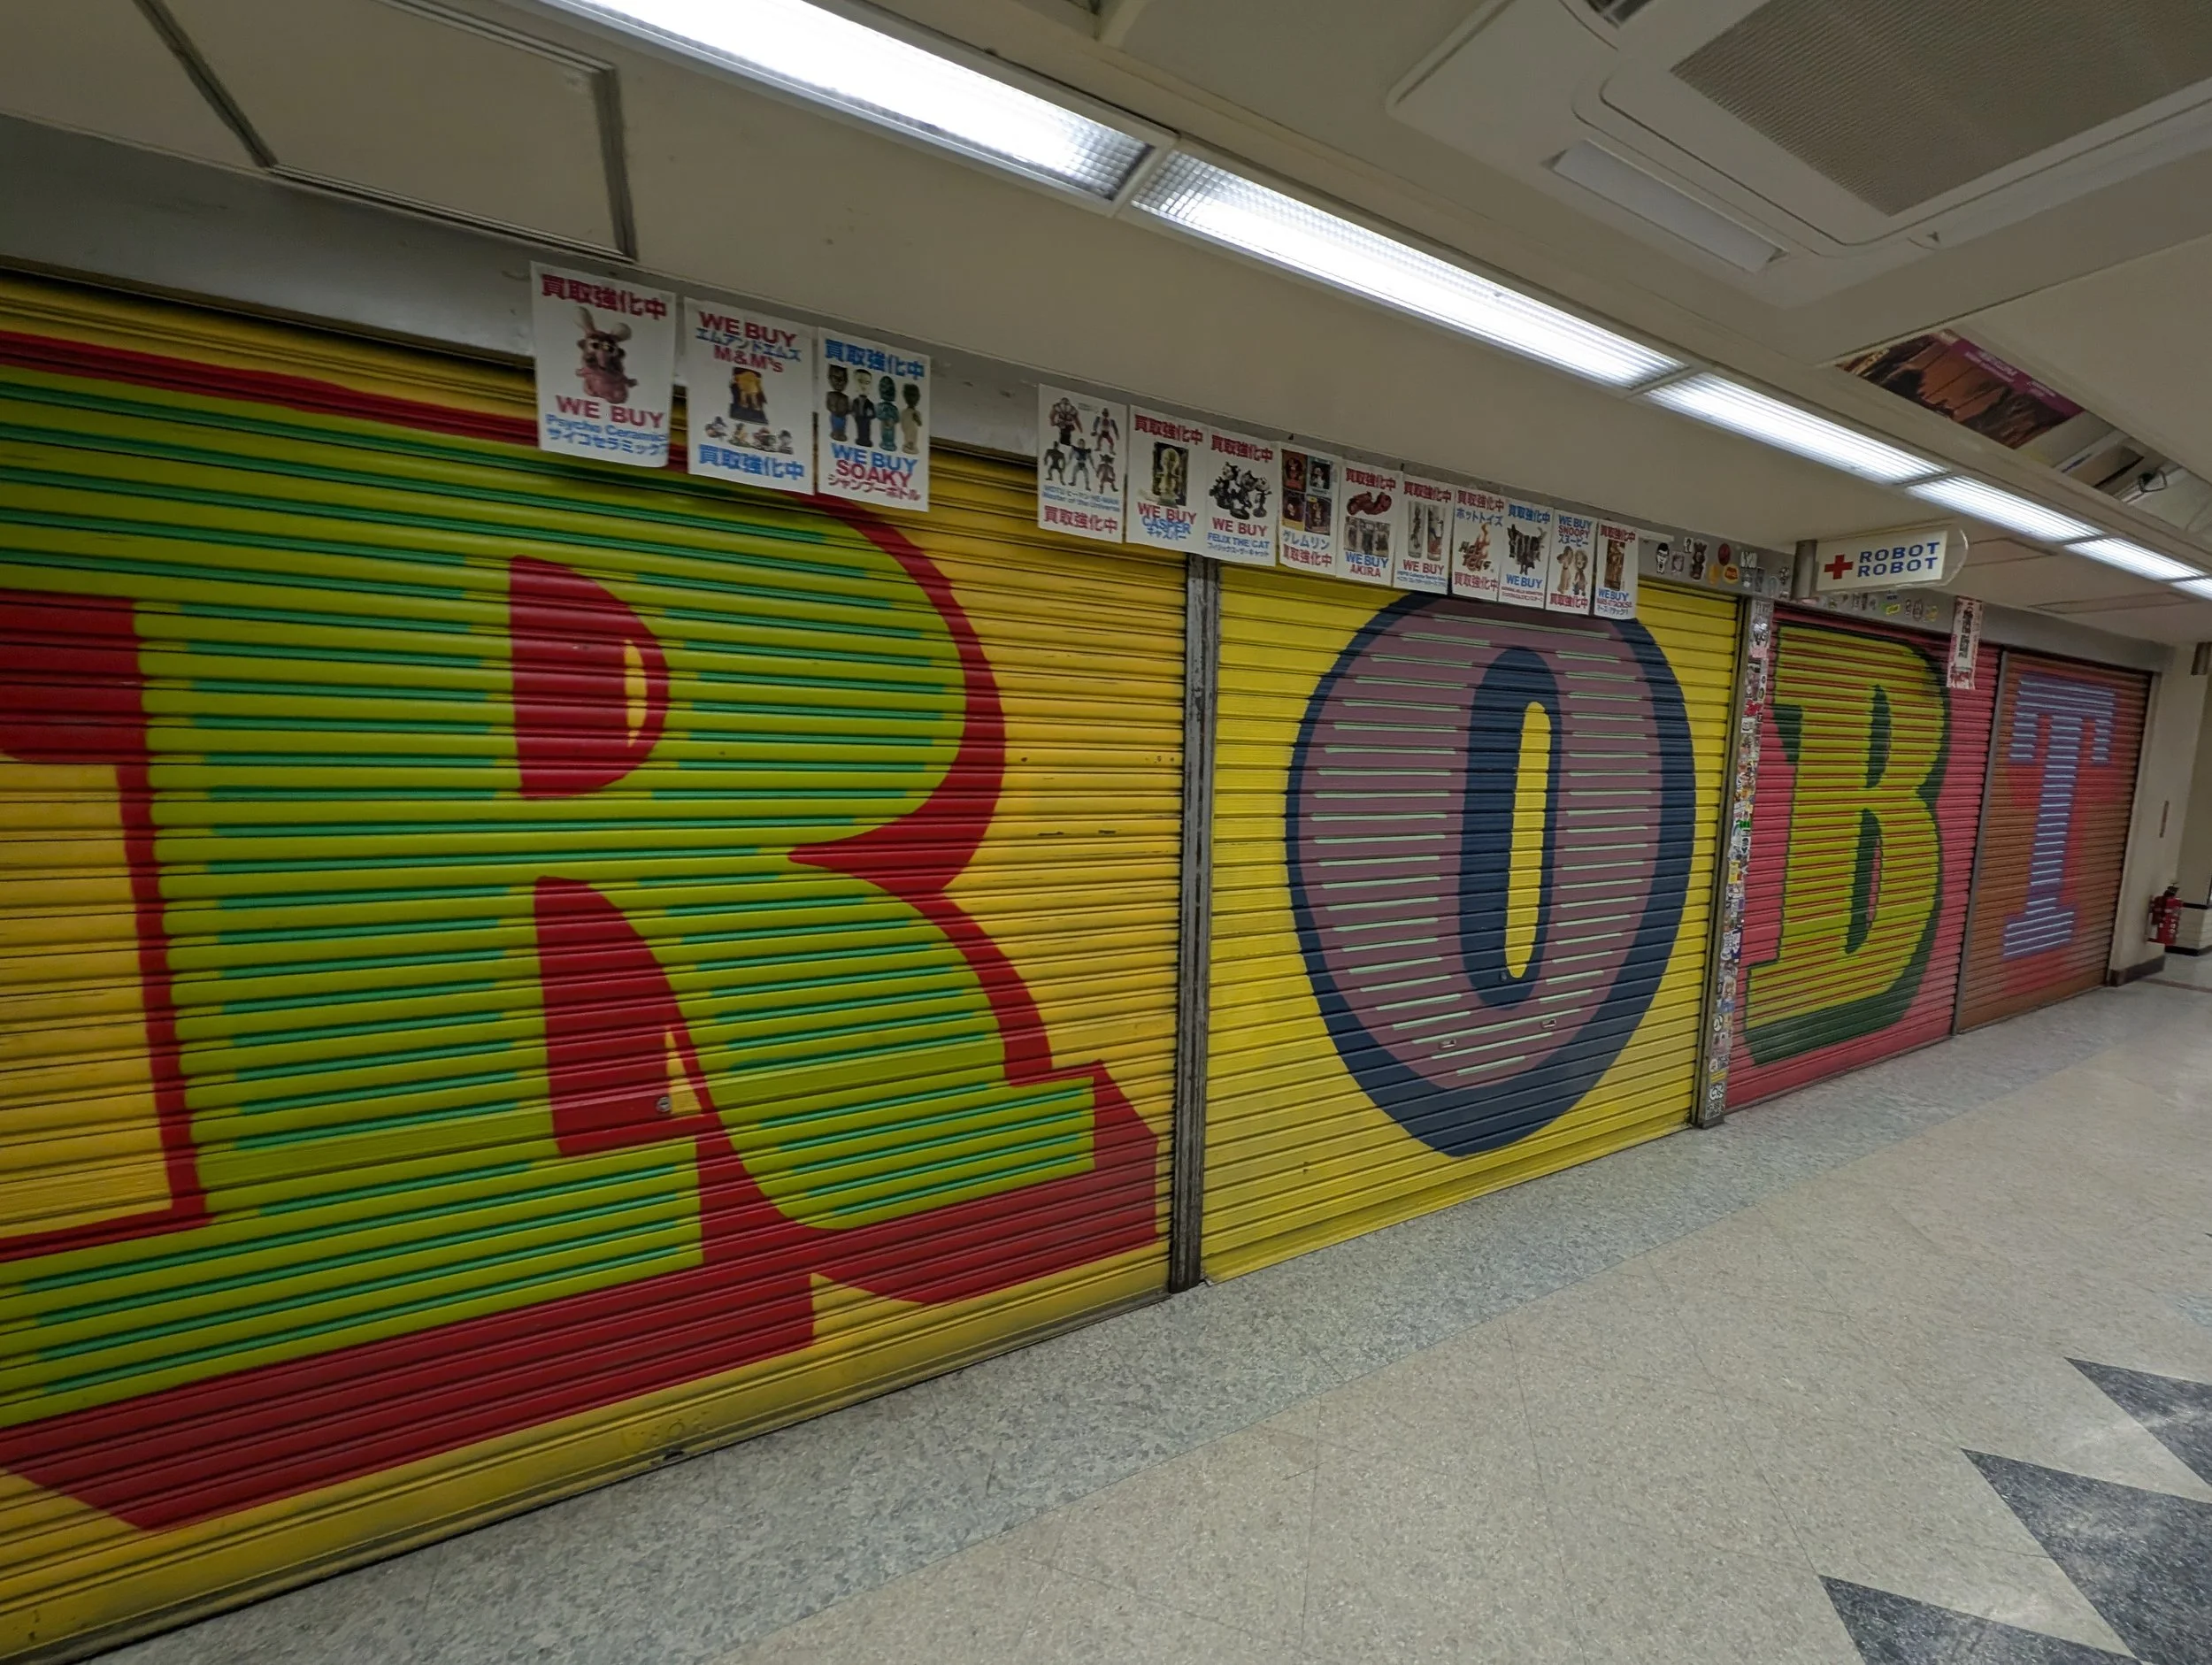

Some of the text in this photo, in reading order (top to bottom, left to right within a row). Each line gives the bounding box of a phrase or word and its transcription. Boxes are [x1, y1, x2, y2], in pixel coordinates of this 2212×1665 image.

[541, 273, 666, 320] 買取強化中
[698, 311, 797, 347] WE BUY
[695, 327, 801, 362] エムアンドエムズ
[713, 345, 783, 372] M&M's
[825, 339, 925, 380] 買取強化中
[555, 395, 664, 428] WE BUY
[1134, 414, 1203, 445] 買取強化中
[831, 442, 918, 472] WE BUY
[1210, 434, 1273, 463] 買取強化中
[698, 444, 804, 480] 買取強化中
[836, 459, 912, 487] SOAKY
[1346, 467, 1396, 491] 買取強化中
[1403, 480, 1452, 503] 買取強化中
[1457, 490, 1504, 512] 買取強化中
[1044, 505, 1118, 533] 買取強化中
[1138, 502, 1197, 526] WE BUY
[1141, 516, 1192, 534] CASPER
[1456, 507, 1503, 526] ホットトイズ
[1508, 503, 1551, 524] 買取強化中
[1558, 515, 1593, 529] WE BUY
[1212, 517, 1268, 537] WE BUY
[1558, 526, 1591, 538] SNOOPY
[1600, 524, 1636, 544] 買取強化中
[1207, 533, 1270, 549] FELIX THE CAT
[1282, 529, 1331, 550] グレムリン
[1283, 543, 1333, 567] 買取強化中
[1345, 551, 1389, 568] WE BUY
[1859, 541, 1939, 564] ROBOT
[1349, 564, 1381, 578] AKIRA
[1402, 559, 1445, 575] WE BUY
[1857, 557, 1939, 577] ROBOT
[1455, 572, 1499, 591] 買取強化中
[1506, 574, 1543, 588] WE BUY
[1549, 593, 1589, 609] 買取強化中
[1598, 587, 1629, 602] WE BUY
[2002, 672, 2117, 962] T
[1744, 621, 1952, 1067] B
[1286, 591, 1697, 1159] O
[0, 341, 1158, 1529] R
